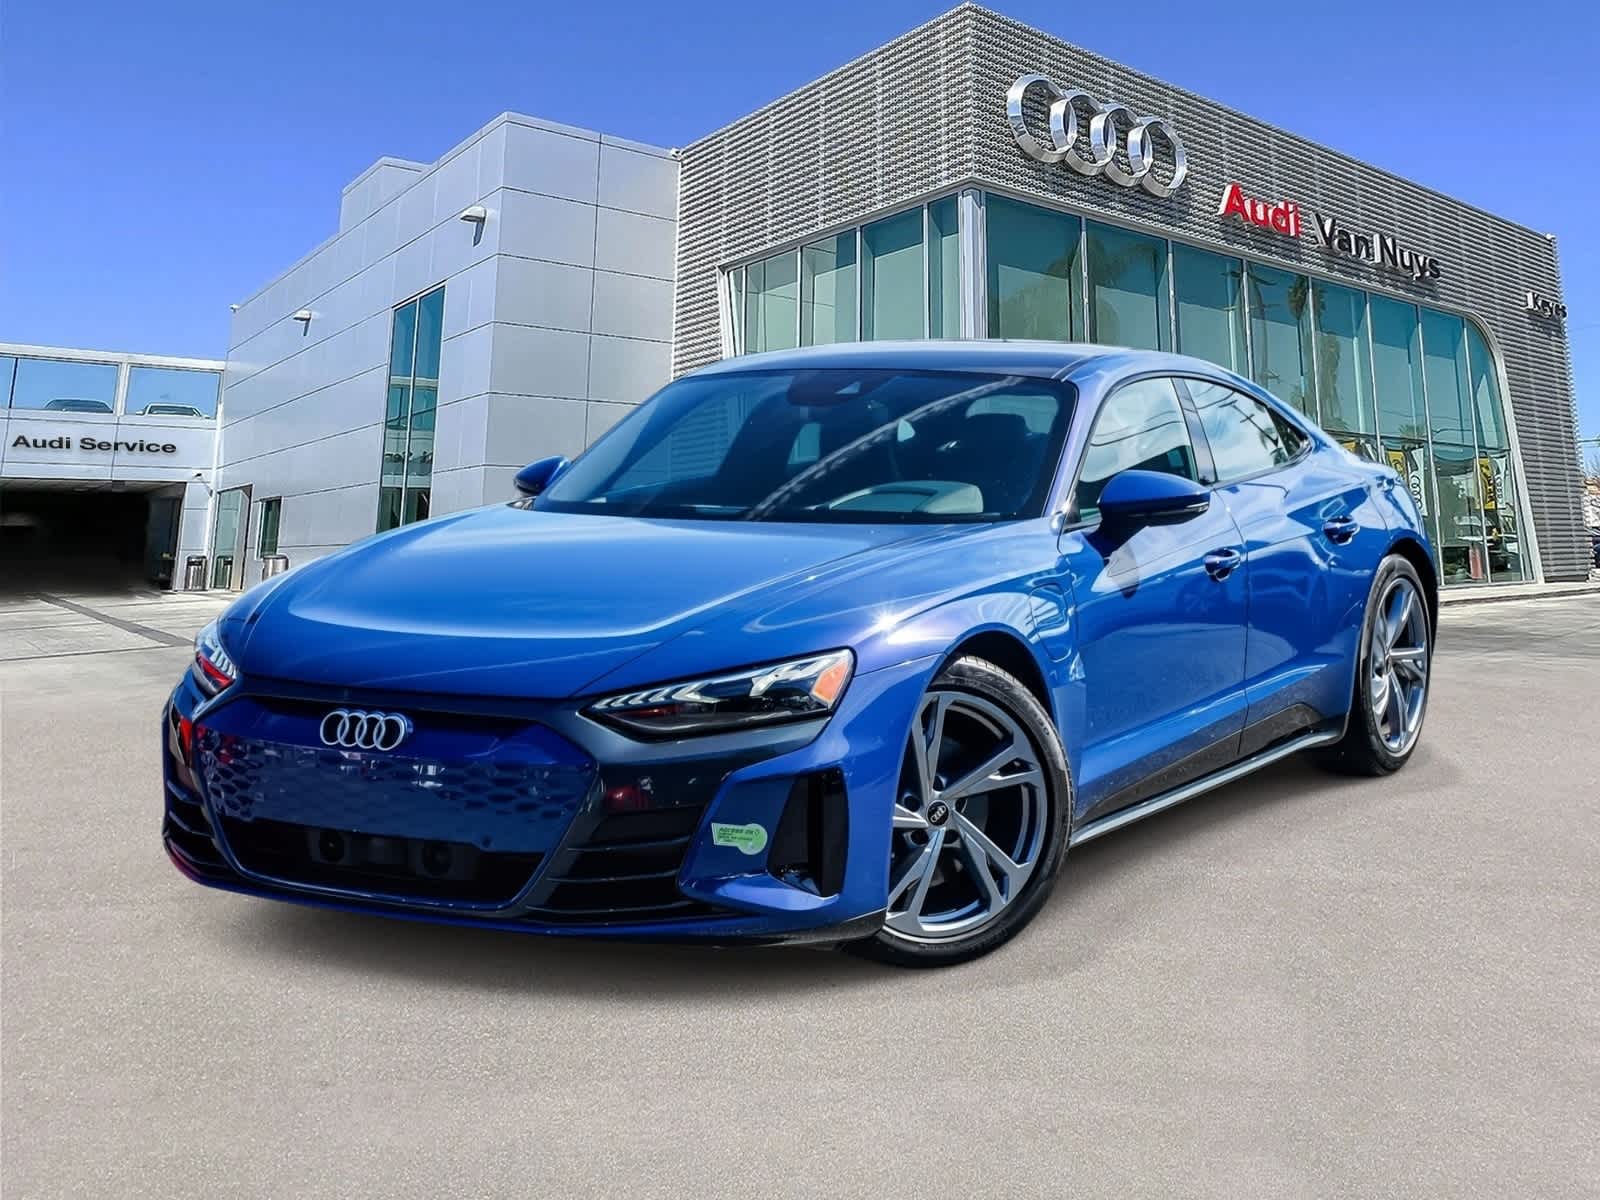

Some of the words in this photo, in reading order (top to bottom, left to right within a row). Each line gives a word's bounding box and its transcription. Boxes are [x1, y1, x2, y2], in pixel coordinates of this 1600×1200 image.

[1217, 181, 1302, 239] Audi
[1311, 212, 1370, 258] Van
[1372, 232, 1441, 281] Nuys
[12, 434, 71, 449] Audi
[79, 437, 177, 453] Service
